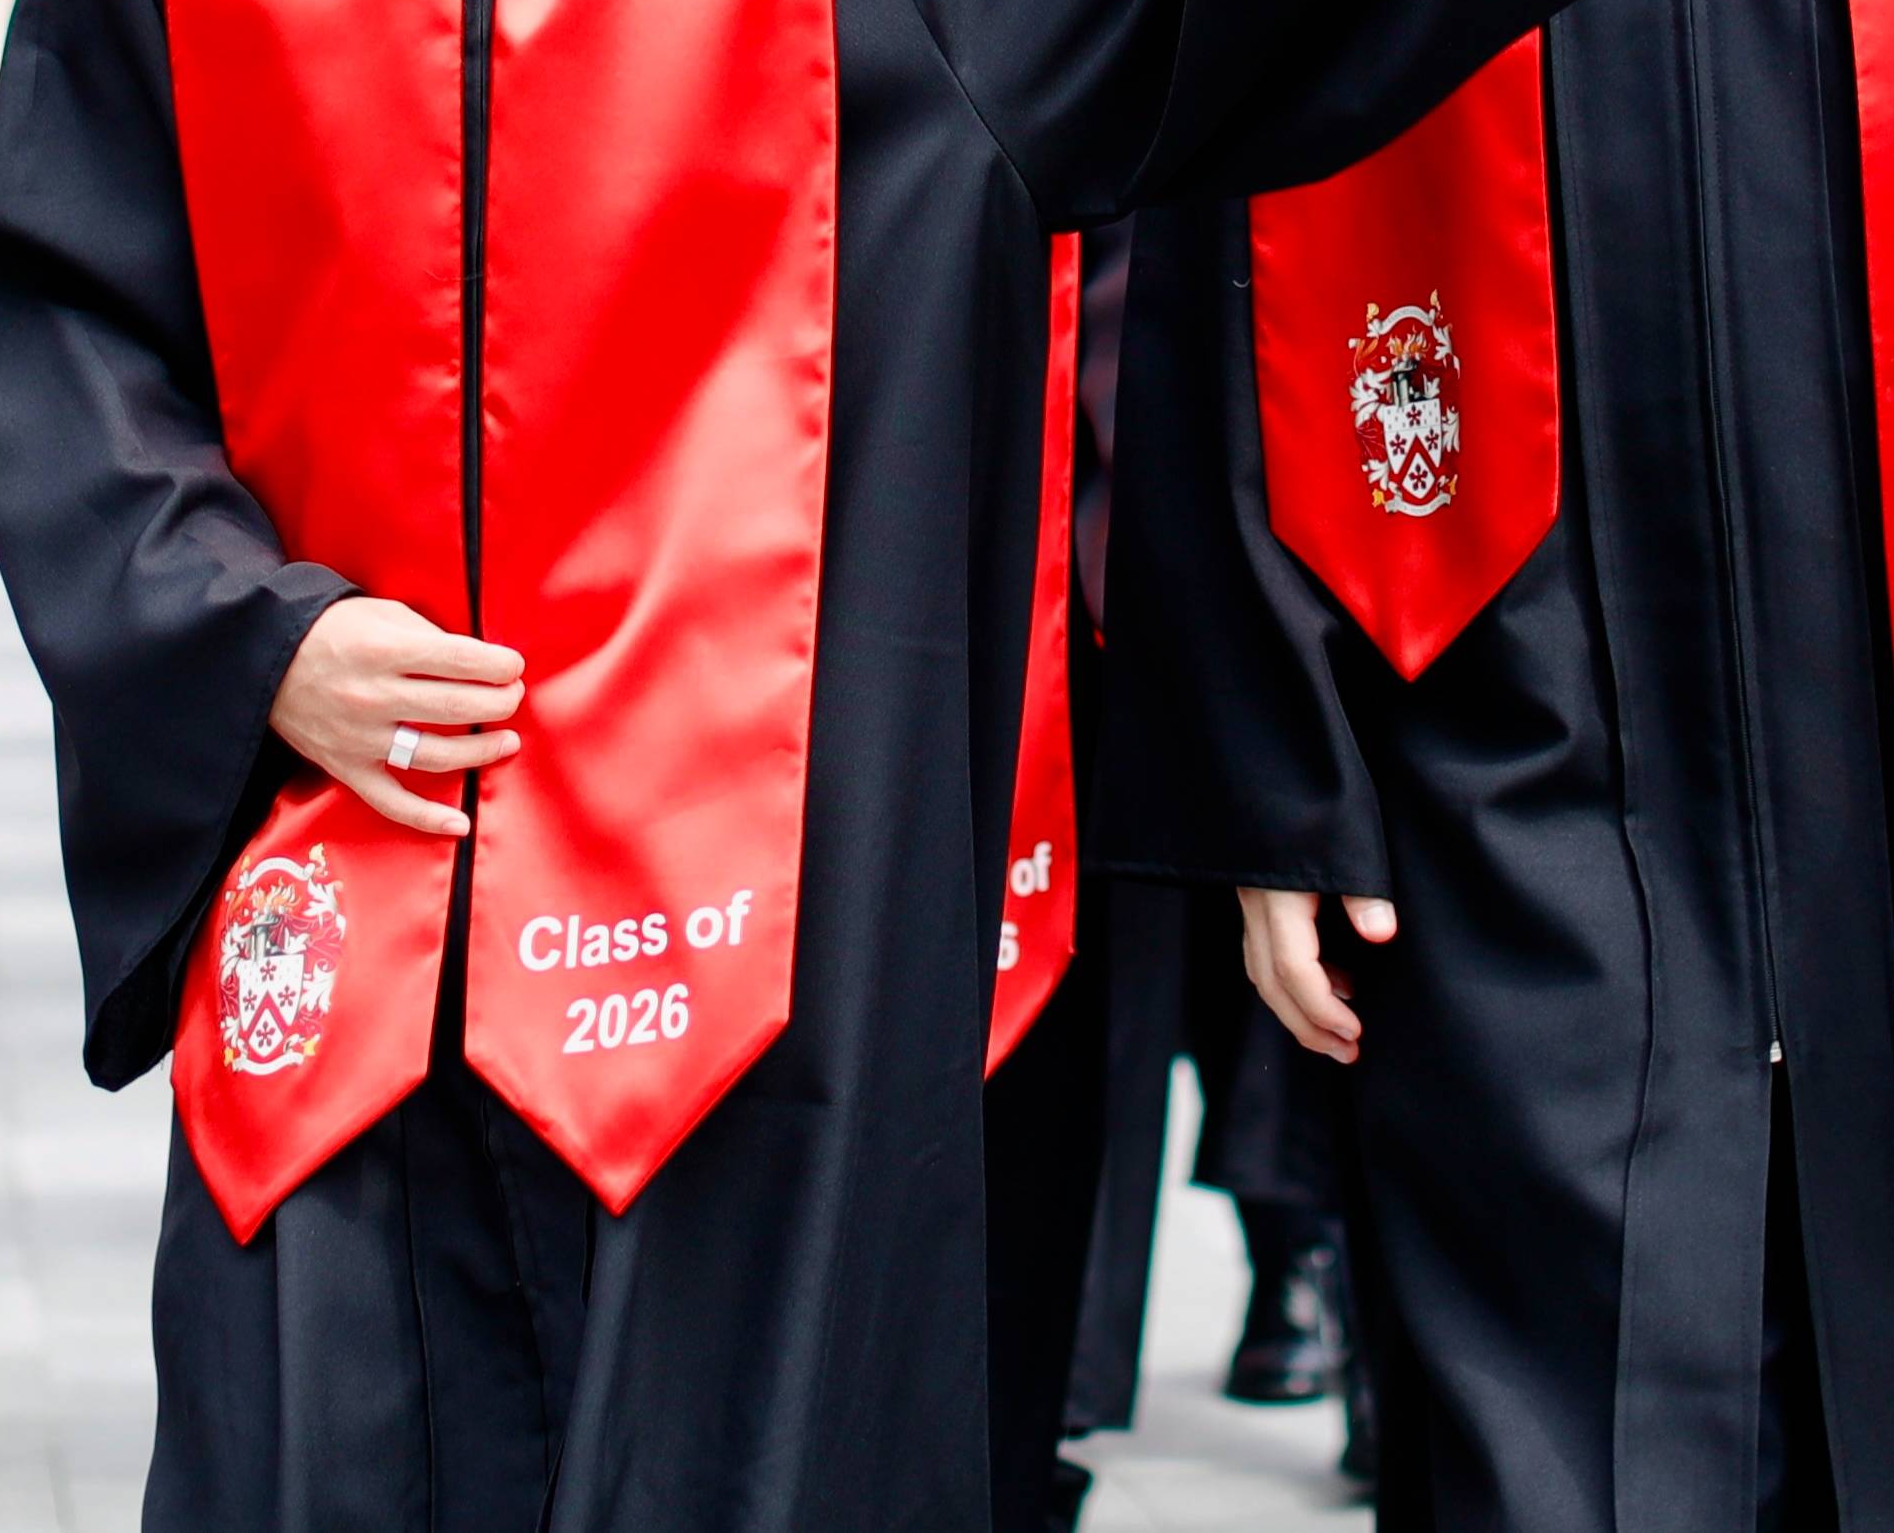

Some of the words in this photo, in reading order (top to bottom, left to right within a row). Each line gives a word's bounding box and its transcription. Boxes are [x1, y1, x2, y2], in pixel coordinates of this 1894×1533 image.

[1009, 840, 1053, 898] of
[516, 912, 669, 974] Class
[683, 889, 754, 950] of
[561, 982, 691, 1055] 2026
